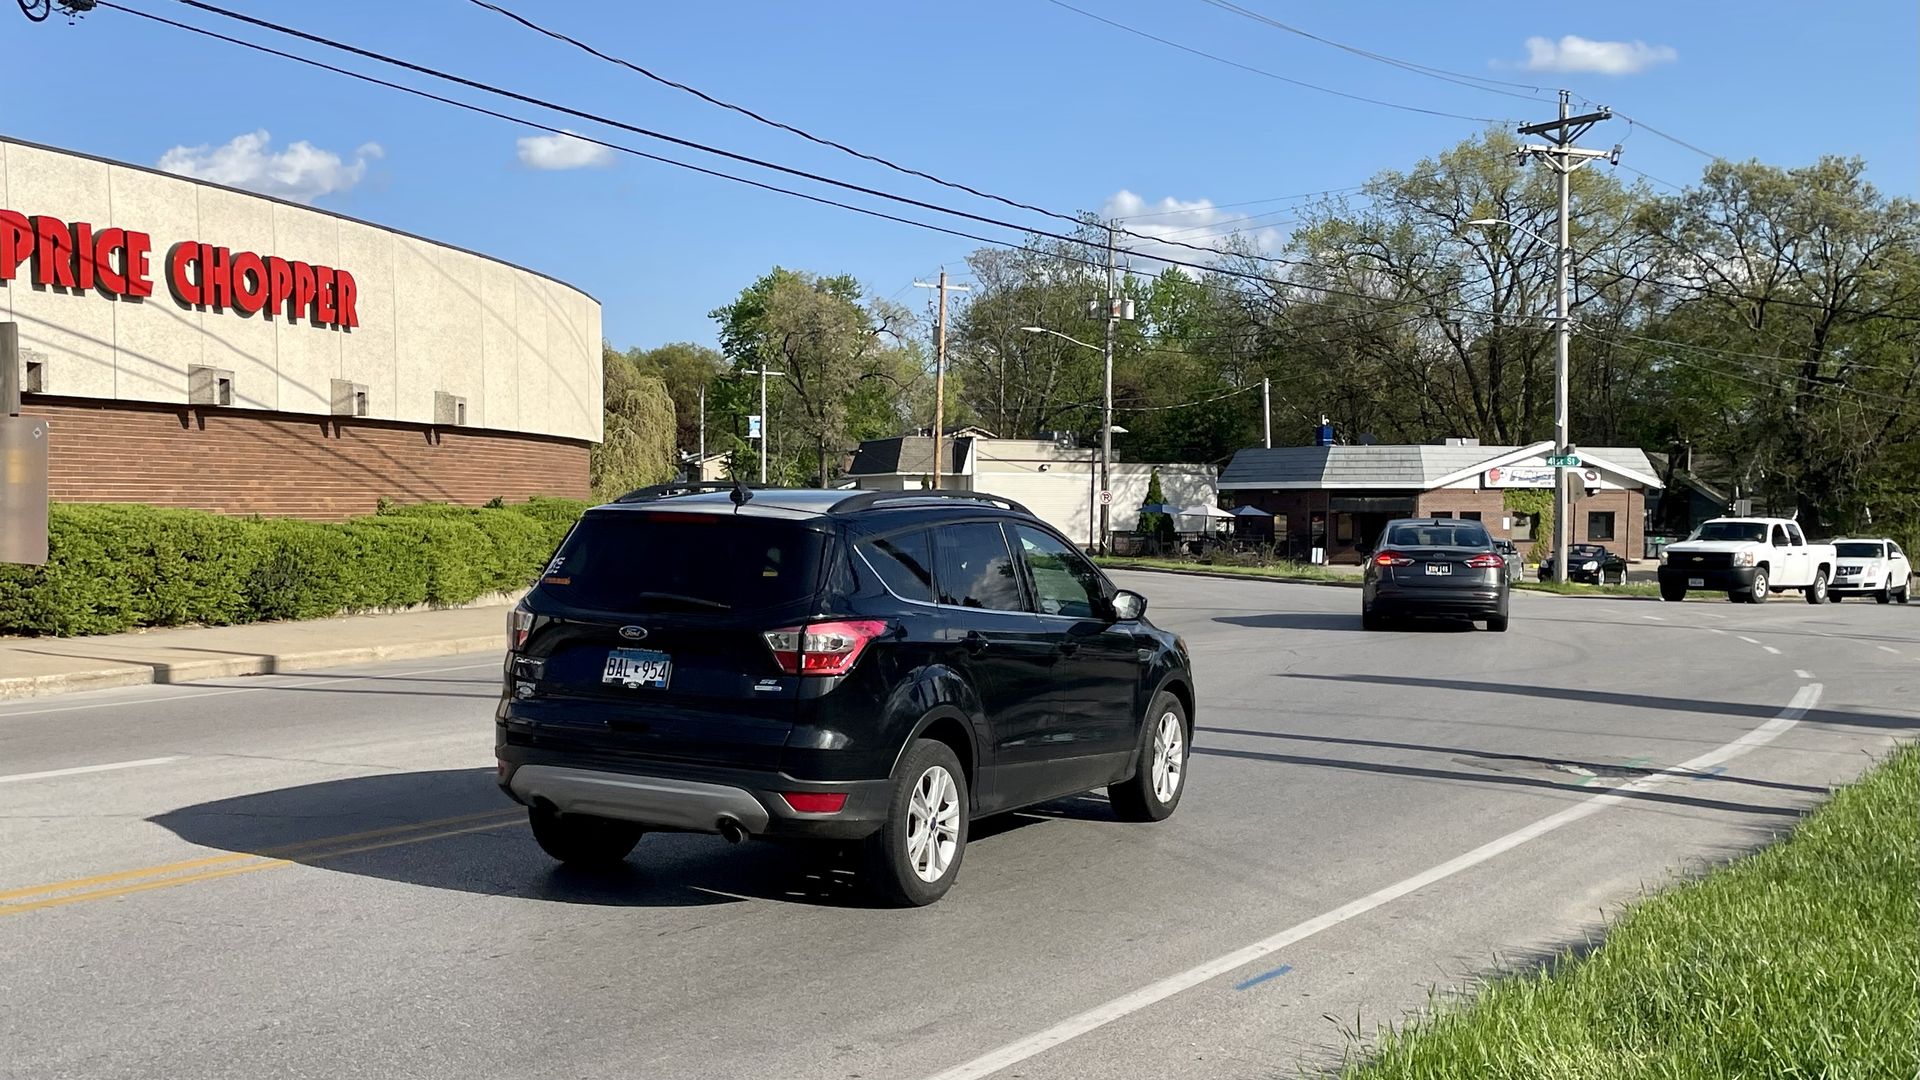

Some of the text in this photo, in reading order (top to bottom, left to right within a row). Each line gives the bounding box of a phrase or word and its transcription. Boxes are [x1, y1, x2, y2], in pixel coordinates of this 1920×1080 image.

[0, 209, 358, 329] PRICE CHOPPER
[1566, 457, 1576, 466] St
[607, 657, 667, 680] BAL 954
